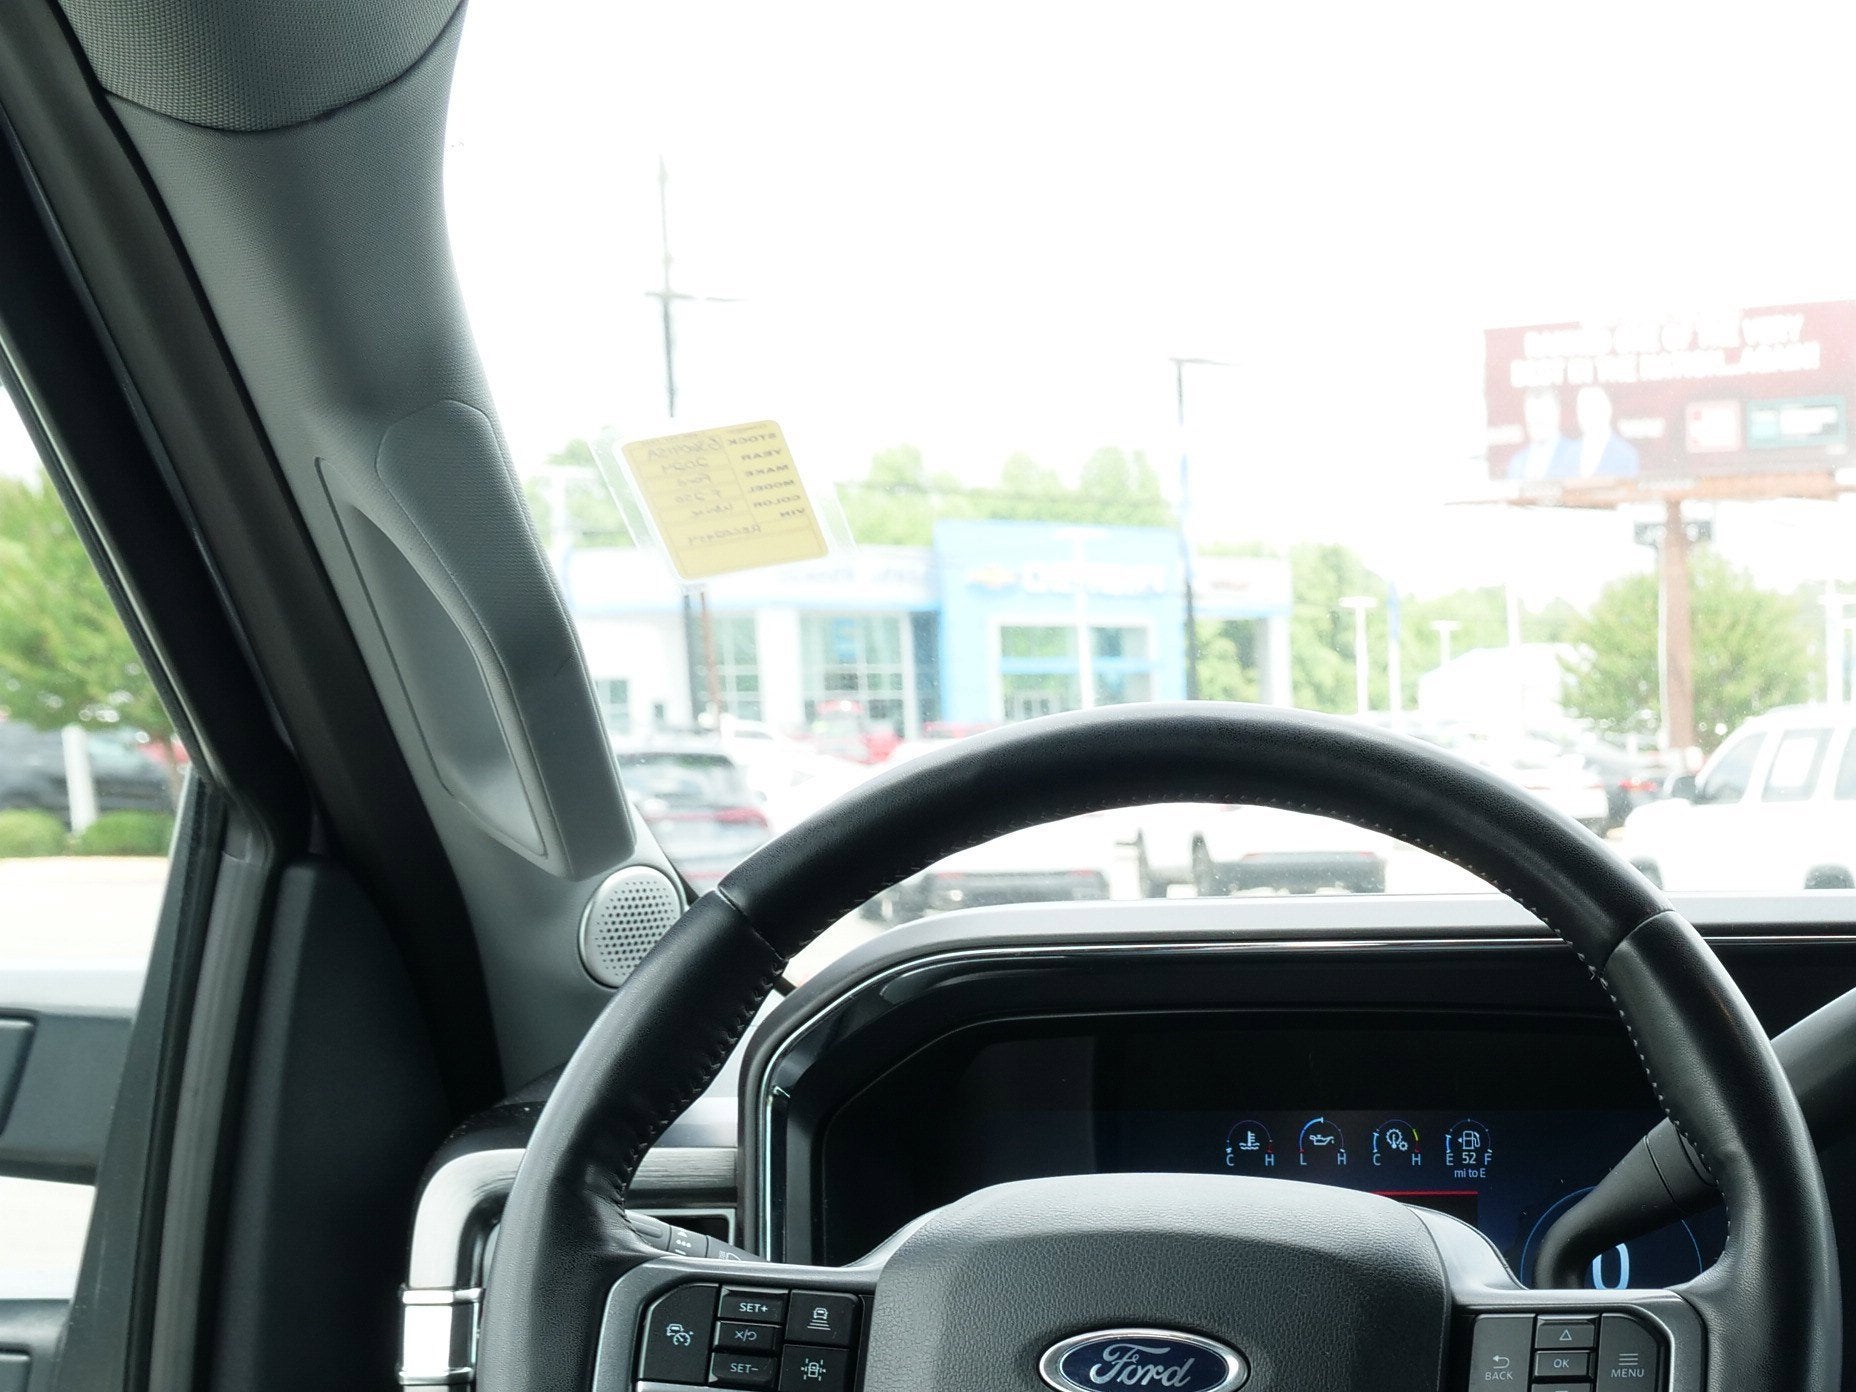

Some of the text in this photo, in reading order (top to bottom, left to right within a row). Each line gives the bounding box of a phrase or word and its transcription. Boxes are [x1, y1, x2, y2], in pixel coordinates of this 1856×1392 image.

[1226, 1154, 1275, 1166] C H
[1300, 1154, 1347, 1166] L H
[1373, 1154, 1421, 1166] C H
[1446, 1152, 1492, 1166] E 52 F
[1454, 1168, 1487, 1178] mi to E
[1592, 1243, 1630, 1290] 0
[739, 1303, 768, 1313] SET+
[1089, 1342, 1196, 1388] Ford
[1553, 1359, 1570, 1369] OK
[1485, 1371, 1514, 1382] BACK
[1610, 1368, 1645, 1379] MENU
